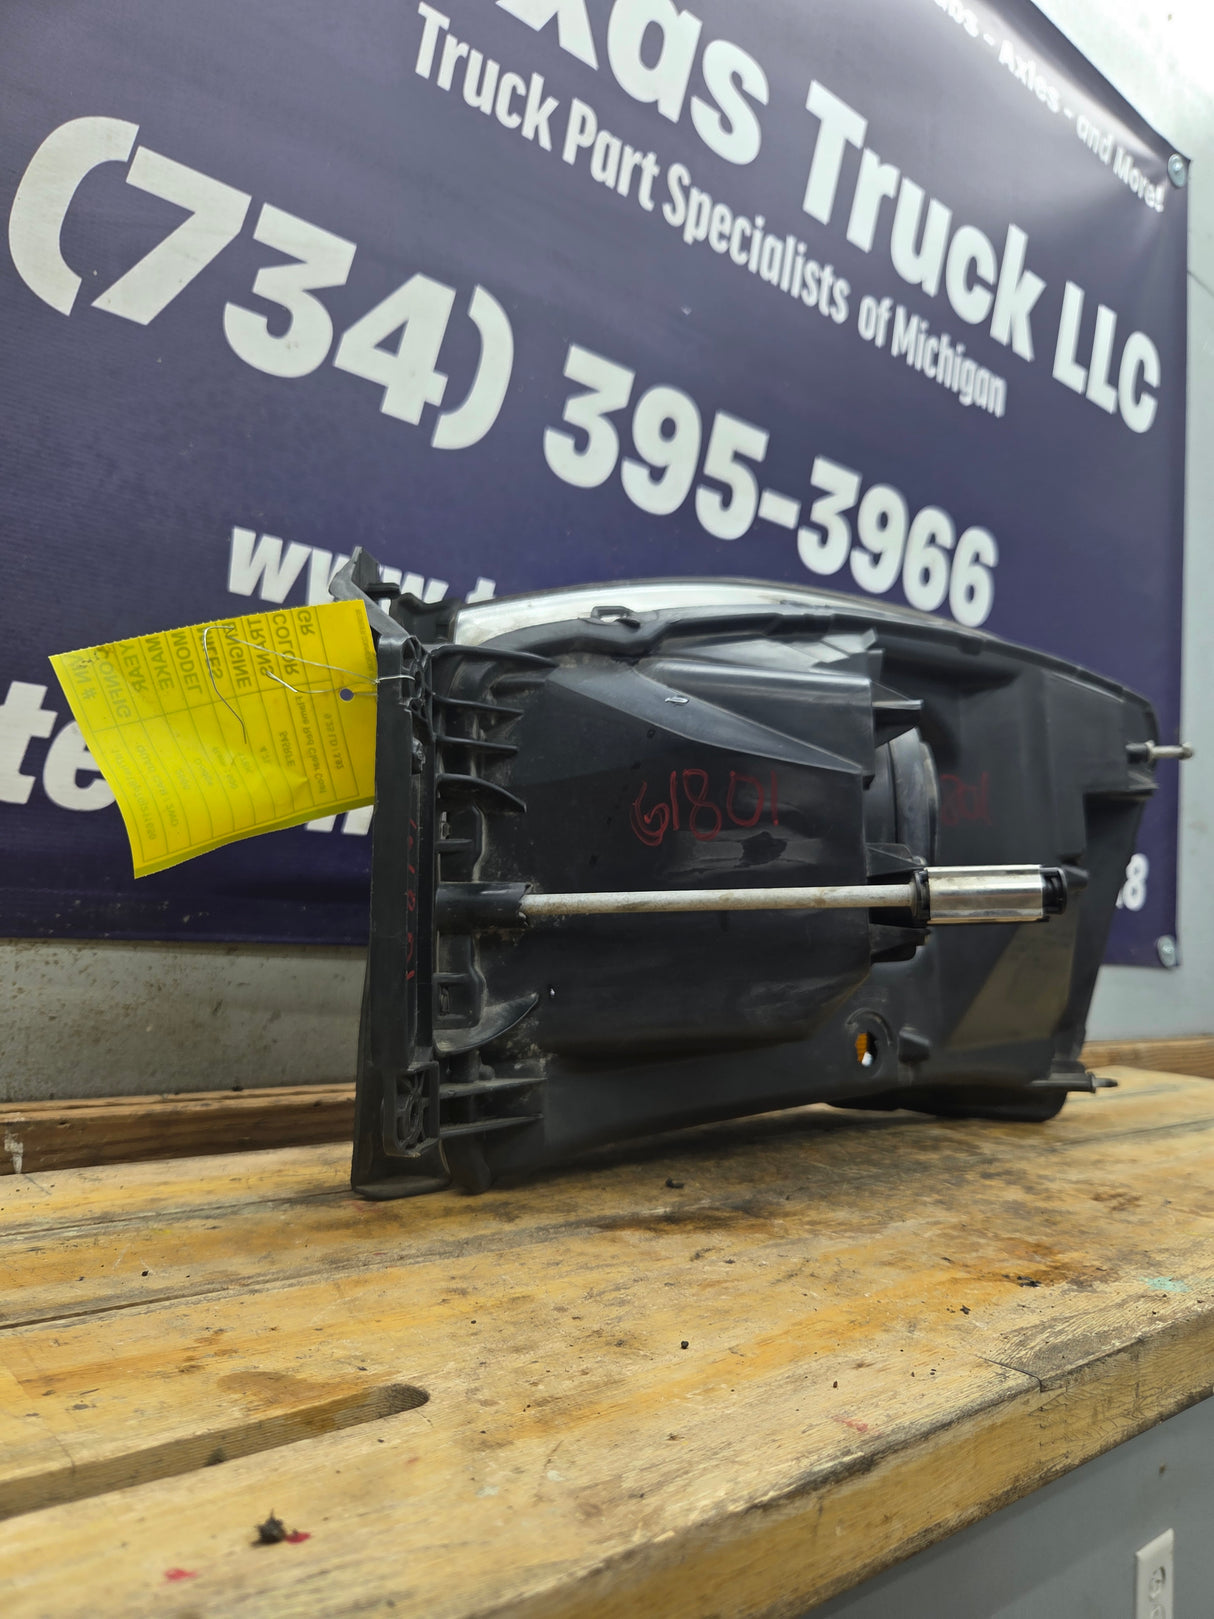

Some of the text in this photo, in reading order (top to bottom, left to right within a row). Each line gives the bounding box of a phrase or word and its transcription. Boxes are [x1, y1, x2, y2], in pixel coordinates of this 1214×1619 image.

[414, 1, 1007, 418] Truck Part Specialists of Michigan
[802, 80, 1047, 362] Truck
[1052, 281, 1161, 433] LLC
[999, 40, 1060, 113] Axles
[1076, 114, 1114, 165] and
[1113, 146, 1166, 212] More!
[8, 116, 999, 627] (734) 395-3966
[631, 769, 779, 846] 61801
[1115, 852, 1149, 911] 8
